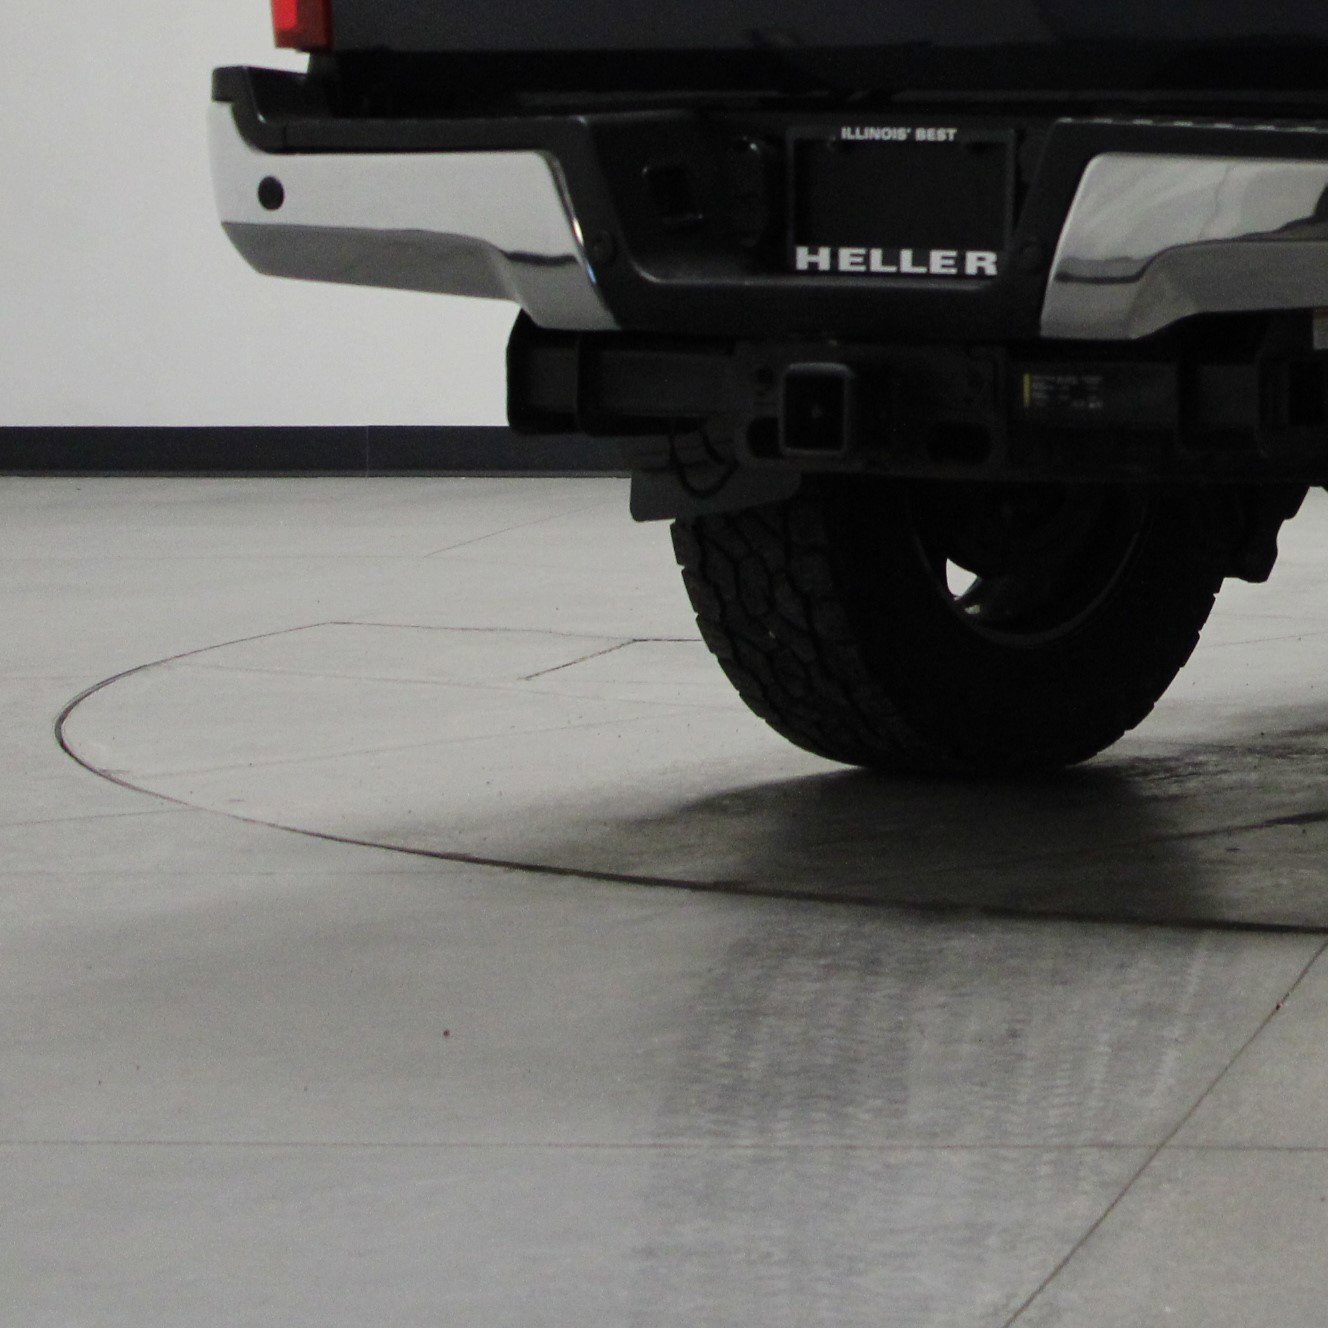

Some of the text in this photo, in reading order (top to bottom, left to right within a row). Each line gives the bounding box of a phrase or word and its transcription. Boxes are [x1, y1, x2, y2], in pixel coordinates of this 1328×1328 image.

[841, 127, 957, 142] ILLINOIS' BEST
[796, 246, 998, 276] HELLER
